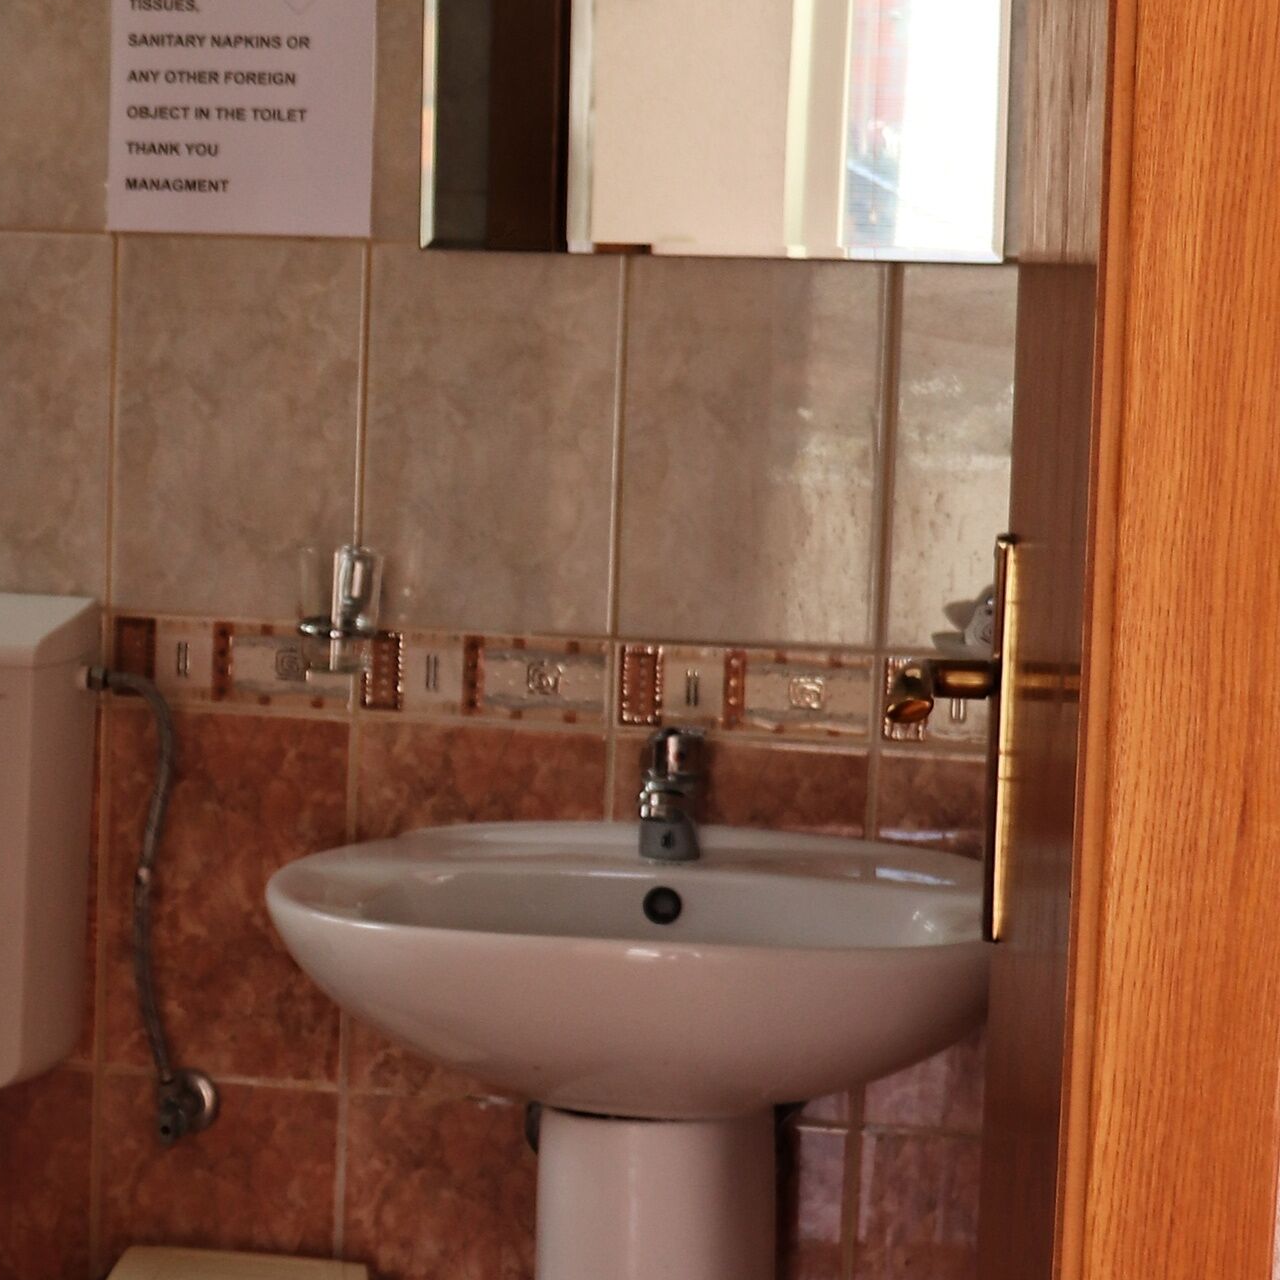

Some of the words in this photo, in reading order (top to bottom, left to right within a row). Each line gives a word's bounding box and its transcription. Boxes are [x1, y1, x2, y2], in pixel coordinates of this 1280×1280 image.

[128, 34, 206, 48] SANITARY
[210, 35, 281, 49] NAPKINS
[286, 36, 310, 50] OR
[127, 70, 160, 84] ANY
[165, 71, 220, 85] OTHER
[224, 72, 296, 86] FOREIGN
[126, 106, 189, 121] OBJECT
[195, 107, 210, 121] IN
[215, 108, 246, 122] THE
[252, 108, 307, 122] TOILET
[126, 142, 181, 157] THANK
[185, 142, 219, 157] YOU
[125, 178, 229, 193] MANAGMENT
